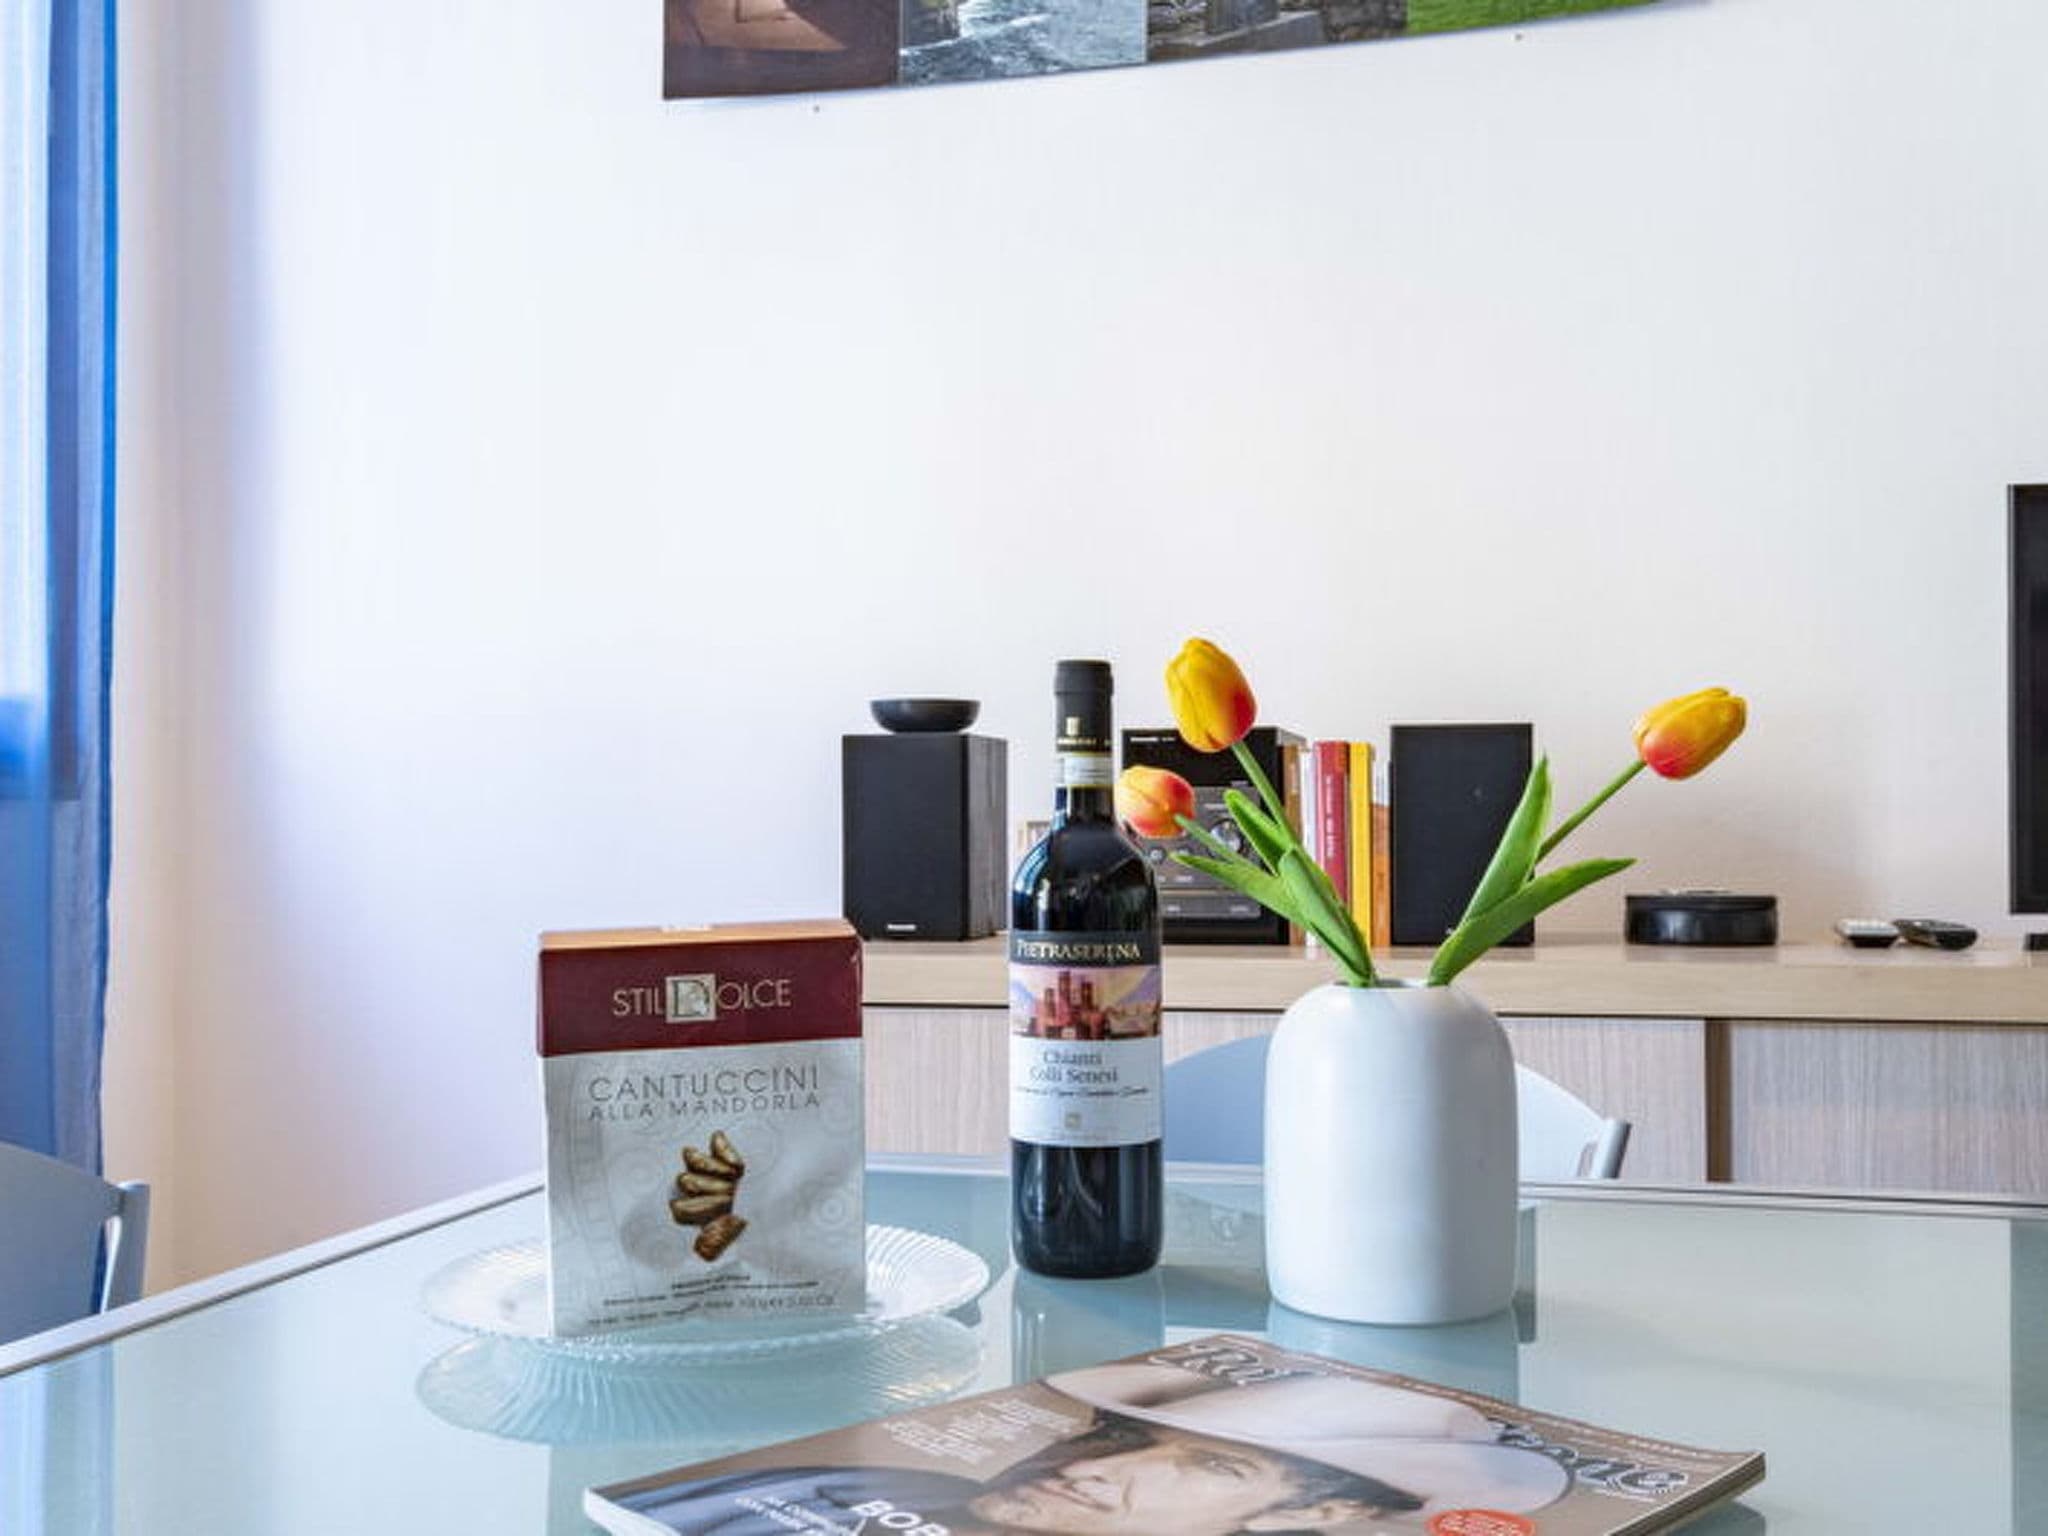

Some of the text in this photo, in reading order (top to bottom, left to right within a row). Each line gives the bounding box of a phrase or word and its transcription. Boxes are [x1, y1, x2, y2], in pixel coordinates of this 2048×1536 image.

[1043, 1049, 1103, 1065] Chianti
[588, 1064, 820, 1101] CANTUCCINI
[1029, 1065, 1119, 1083] Colli Senesi
[588, 1092, 821, 1122] ALLA MANDORLA
